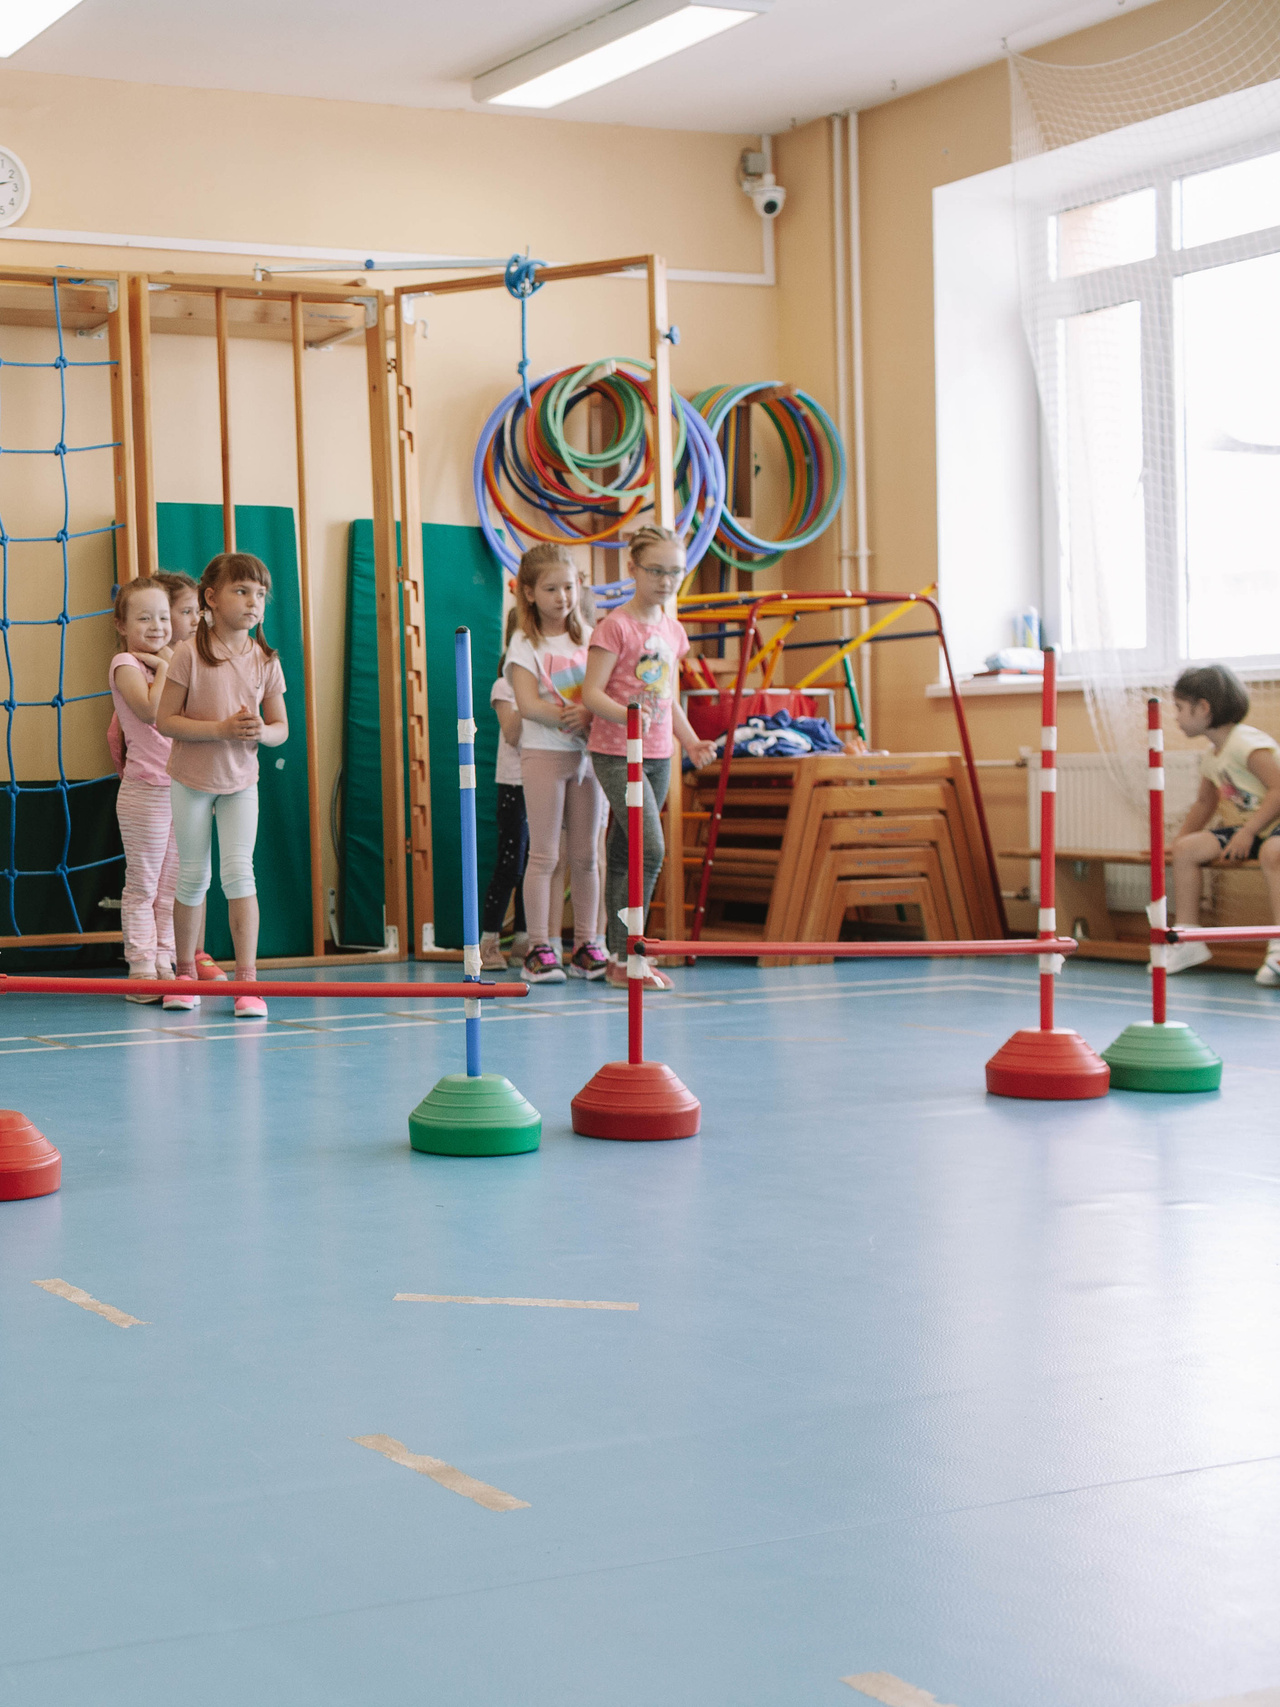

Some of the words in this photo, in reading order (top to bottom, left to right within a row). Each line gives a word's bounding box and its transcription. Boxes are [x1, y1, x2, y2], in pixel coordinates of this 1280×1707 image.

[0, 159, 5, 169] 1
[8, 169, 15, 179] 2
[12, 183, 19, 192] 3
[8, 197, 15, 206] 4
[0, 205, 5, 215] 5
